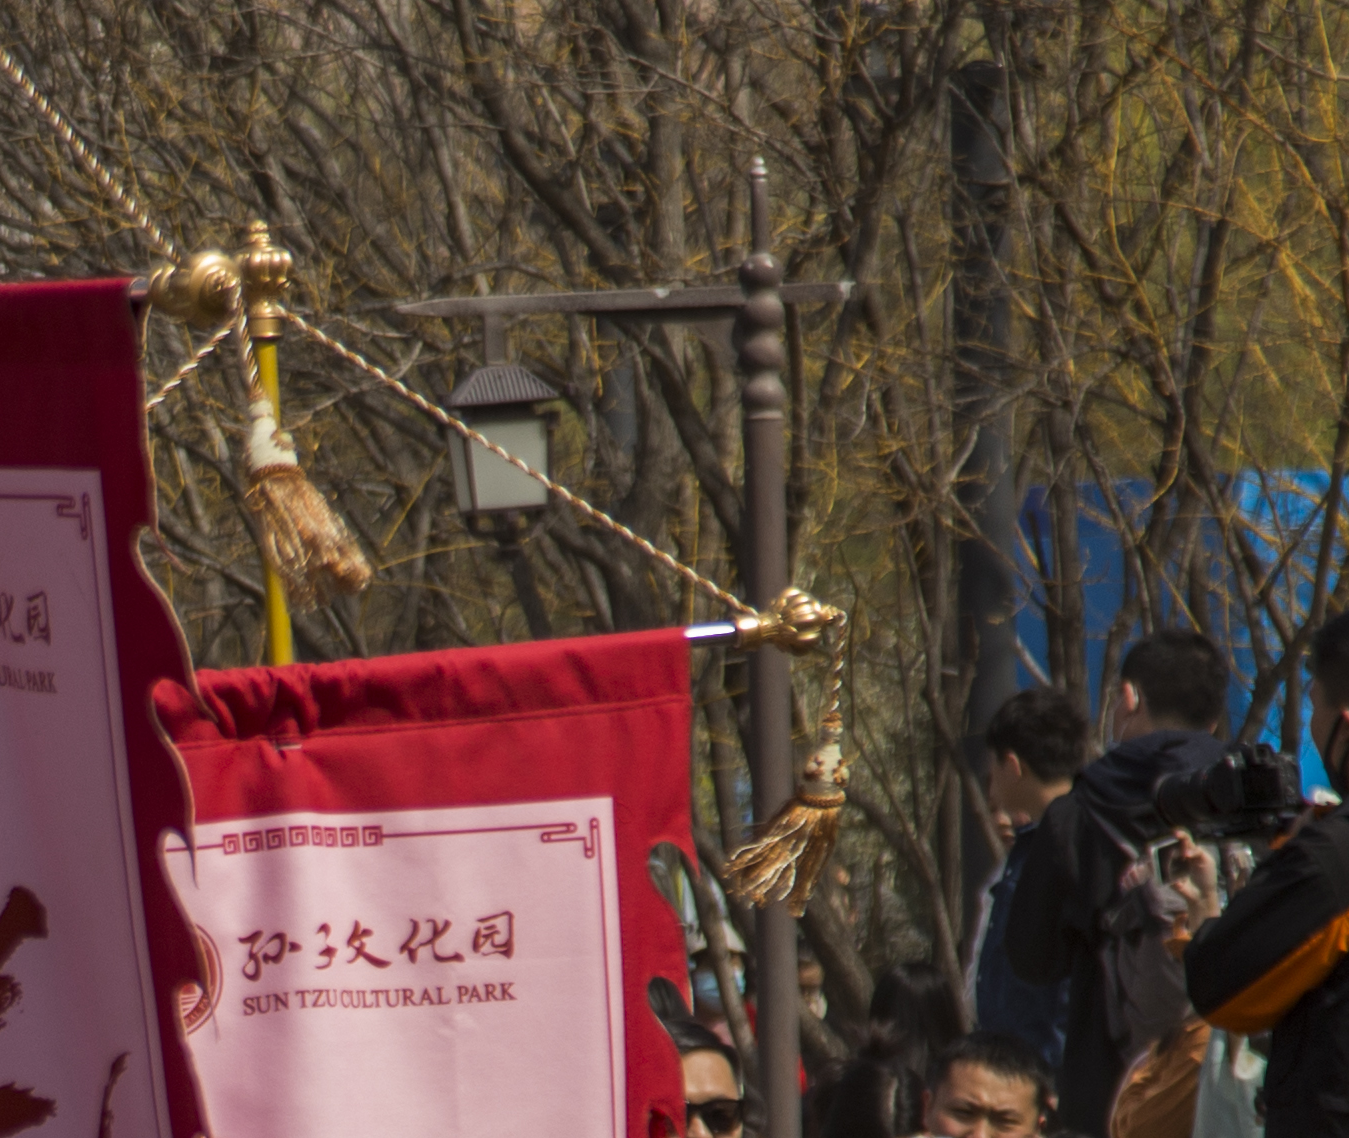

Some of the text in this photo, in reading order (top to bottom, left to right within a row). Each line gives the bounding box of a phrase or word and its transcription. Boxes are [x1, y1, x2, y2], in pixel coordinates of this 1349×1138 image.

[25, 668, 58, 694] PARK
[237, 909, 516, 982] 孙子文化园
[242, 991, 290, 1017] SUN
[296, 988, 338, 1010] TZU
[340, 986, 452, 1009] CULTURAL
[457, 981, 519, 1004] PARK
